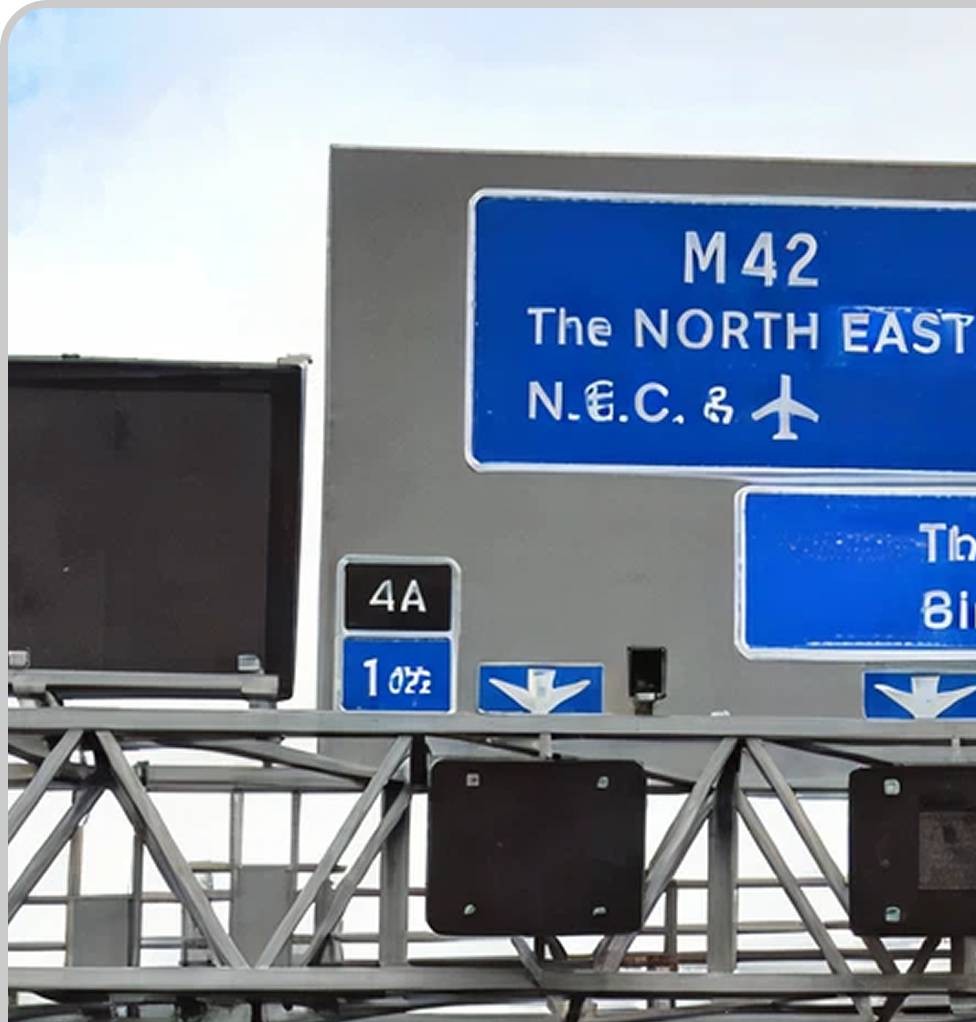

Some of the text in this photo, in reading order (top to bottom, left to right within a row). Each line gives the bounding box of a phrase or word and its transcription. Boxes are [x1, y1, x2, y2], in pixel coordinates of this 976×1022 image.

[527, 307, 975, 354] The NORTH EAST
[368, 579, 428, 613] 4A
